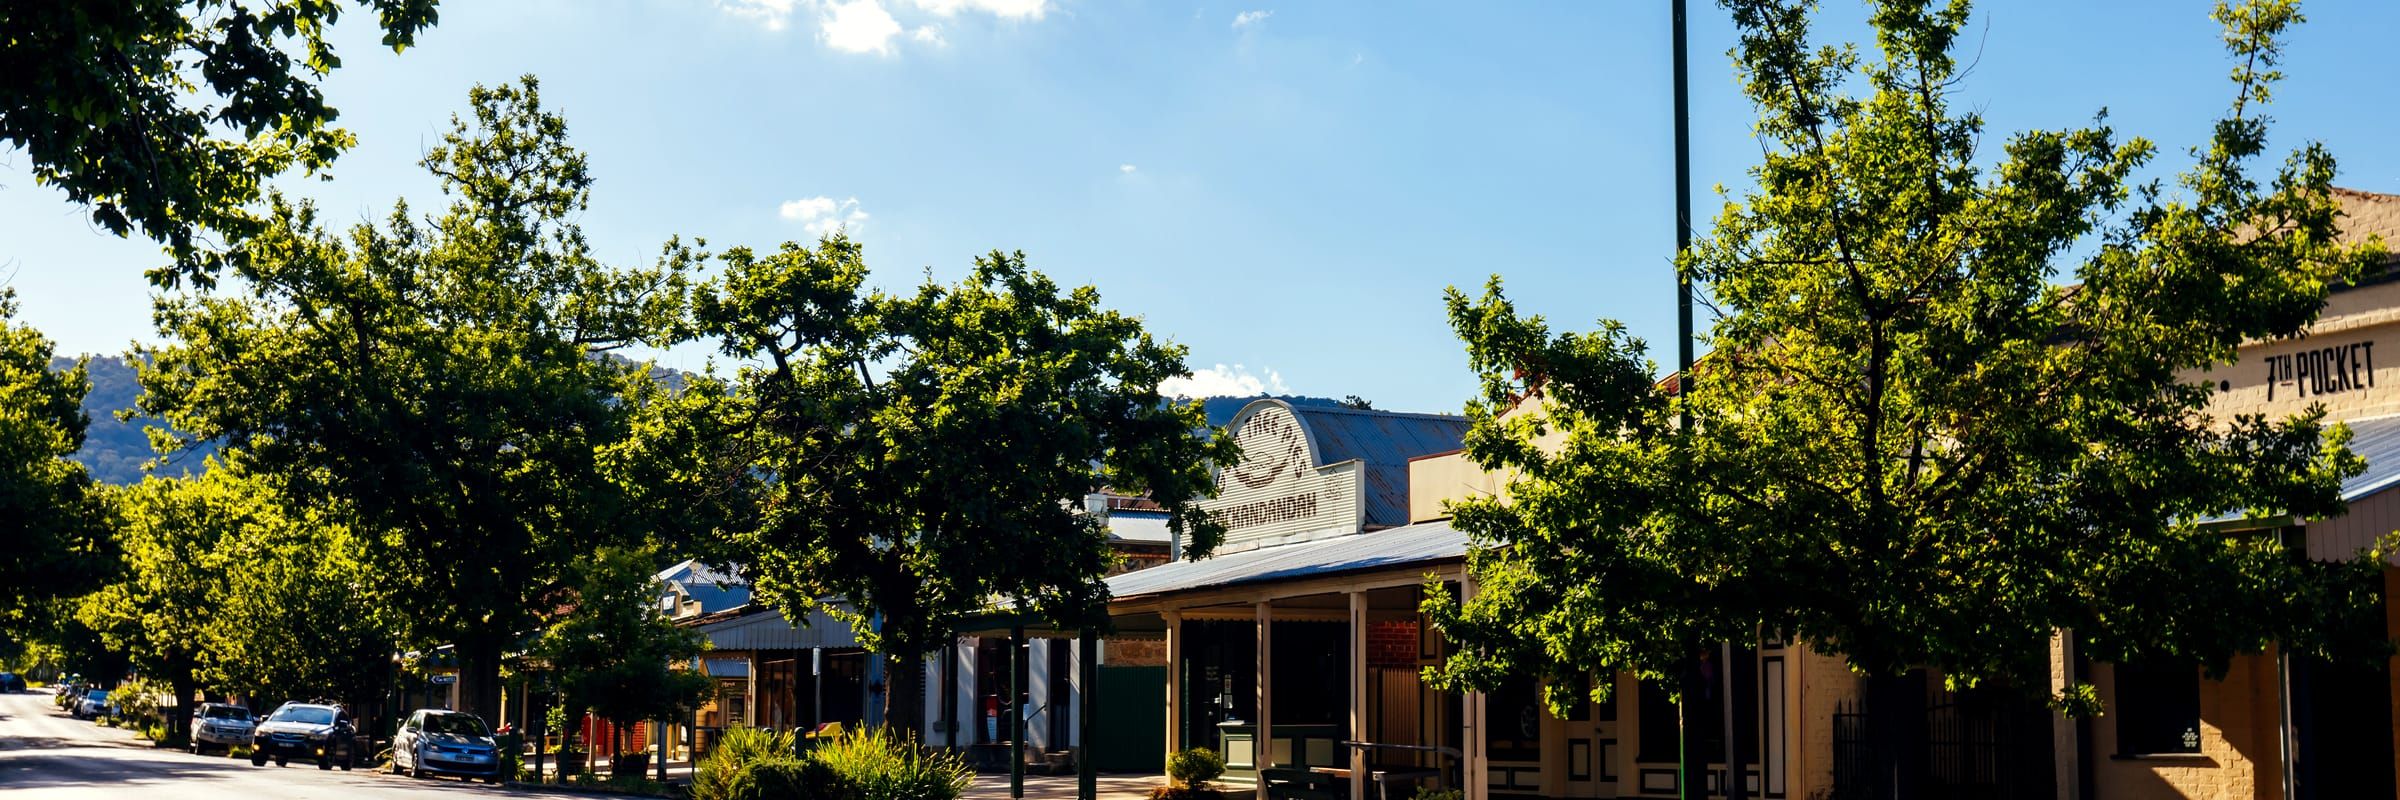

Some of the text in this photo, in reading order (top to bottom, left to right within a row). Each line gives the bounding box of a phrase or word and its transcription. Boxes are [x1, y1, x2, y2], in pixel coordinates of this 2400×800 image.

[2264, 341, 2375, 402] 7TH POCKET
[1245, 411, 1280, 440] TREE
[1281, 423, 1308, 479] PIES
